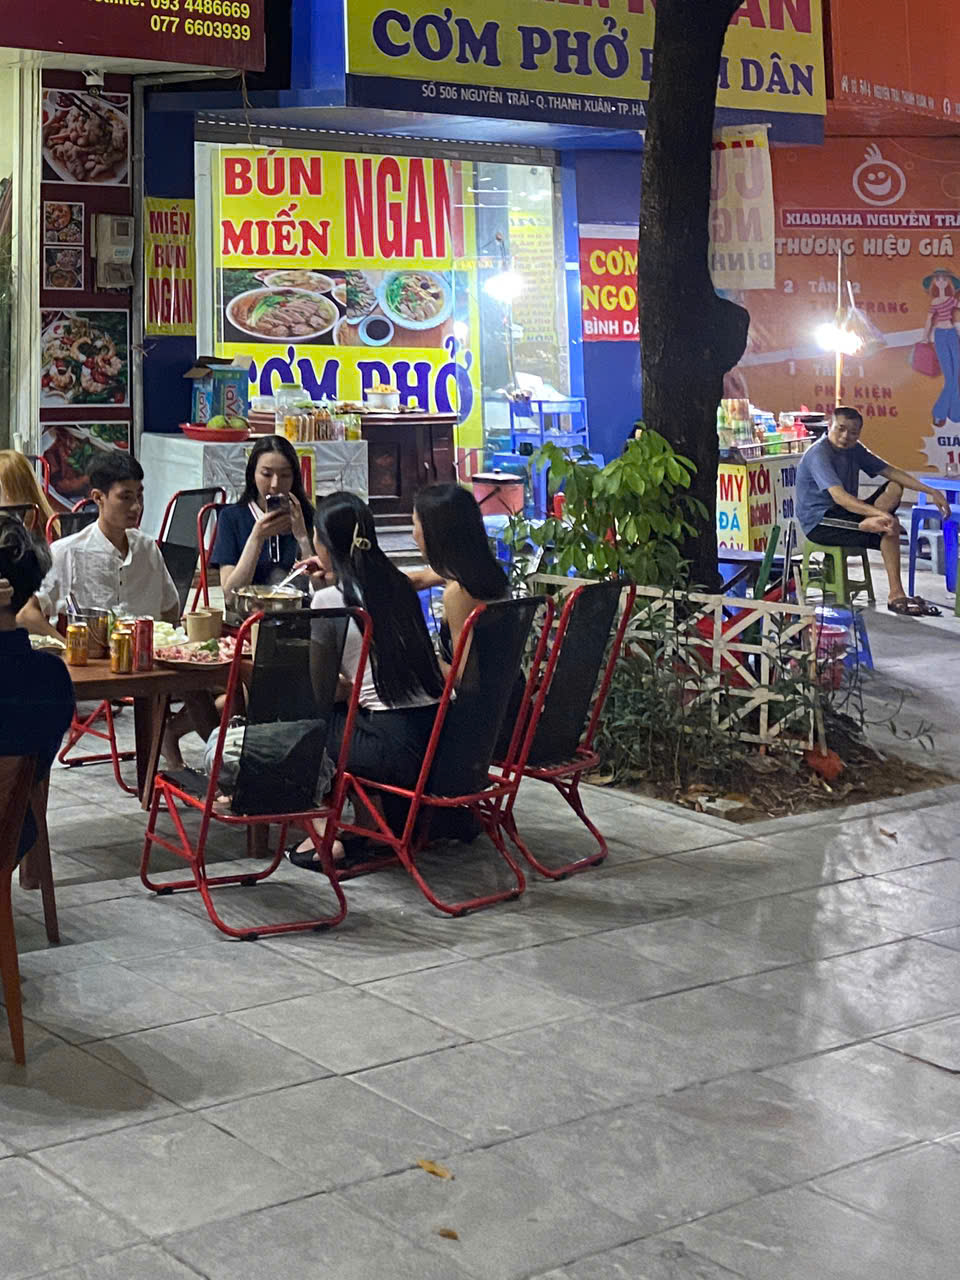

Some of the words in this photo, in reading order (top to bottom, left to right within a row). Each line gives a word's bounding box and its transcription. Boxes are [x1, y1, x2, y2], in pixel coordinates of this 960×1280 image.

[150, 15, 180, 33] 077
[184, 19, 251, 41] 6603939
[372, 7, 502, 67] CƠM
[517, 16, 629, 79] PHỞ
[740, 51, 814, 97] DÂN
[422, 81, 436, 97] SỐ
[440, 85, 458, 100] 506
[461, 86, 503, 104] NGUYỄN
[224, 149, 322, 195] BÚN
[344, 156, 465, 259] NGAN
[149, 204, 191, 235] MIẾN
[221, 203, 331, 257] MIẾN
[786, 213, 863, 226] XIAOHAHA
[867, 209, 930, 228] NGUYỄN
[154, 240, 187, 268] BÚN
[775, 235, 855, 256] THƯƠNG
[863, 234, 911, 259] HIỆU
[919, 234, 953, 256] GIÁ
[148, 277, 193, 324] NGAN
[581, 285, 638, 311] NGO
[584, 316, 619, 335] BÌNH
[719, 468, 744, 502] MỲ
[719, 507, 741, 532] ĐÁ
